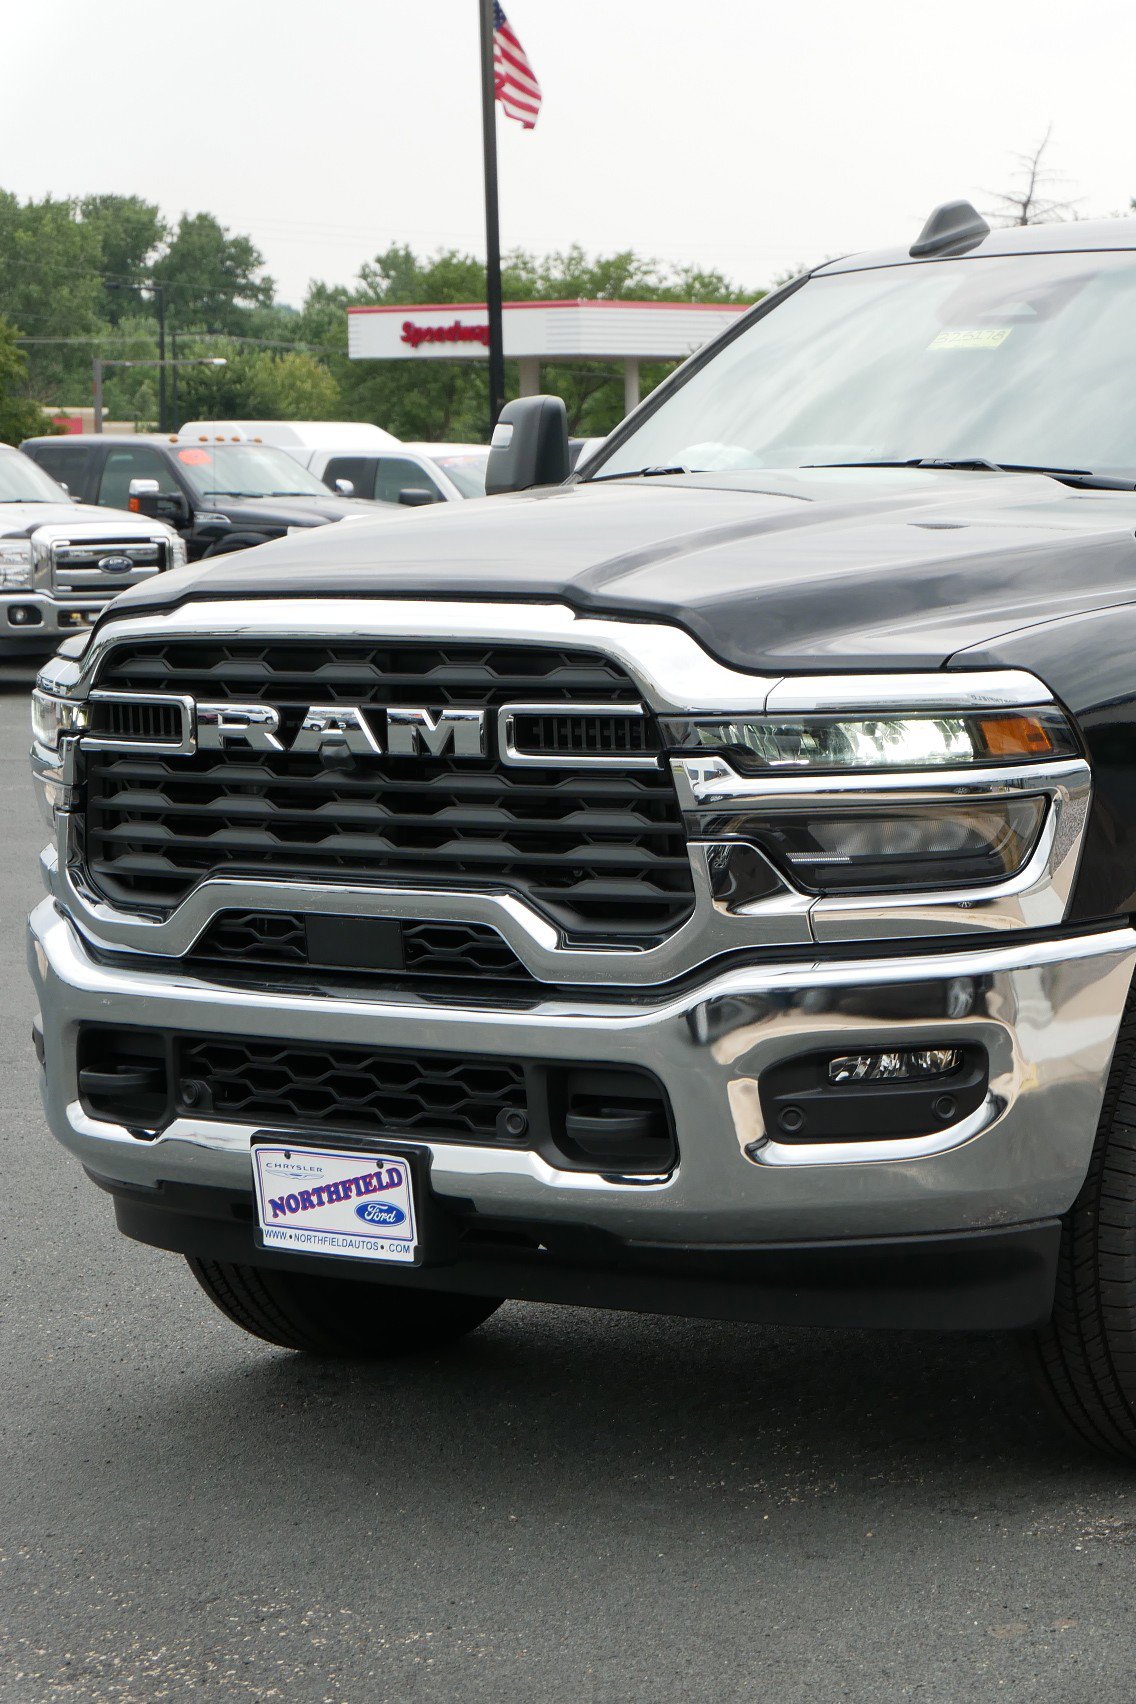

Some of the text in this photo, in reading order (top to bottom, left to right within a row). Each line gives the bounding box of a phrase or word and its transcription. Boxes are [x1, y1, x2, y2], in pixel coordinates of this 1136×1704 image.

[197, 702, 485, 757] RAM
[266, 1162, 323, 1173] CHRYSLER
[268, 1167, 403, 1219] NORTHFIELD
[364, 1204, 396, 1223] Ford
